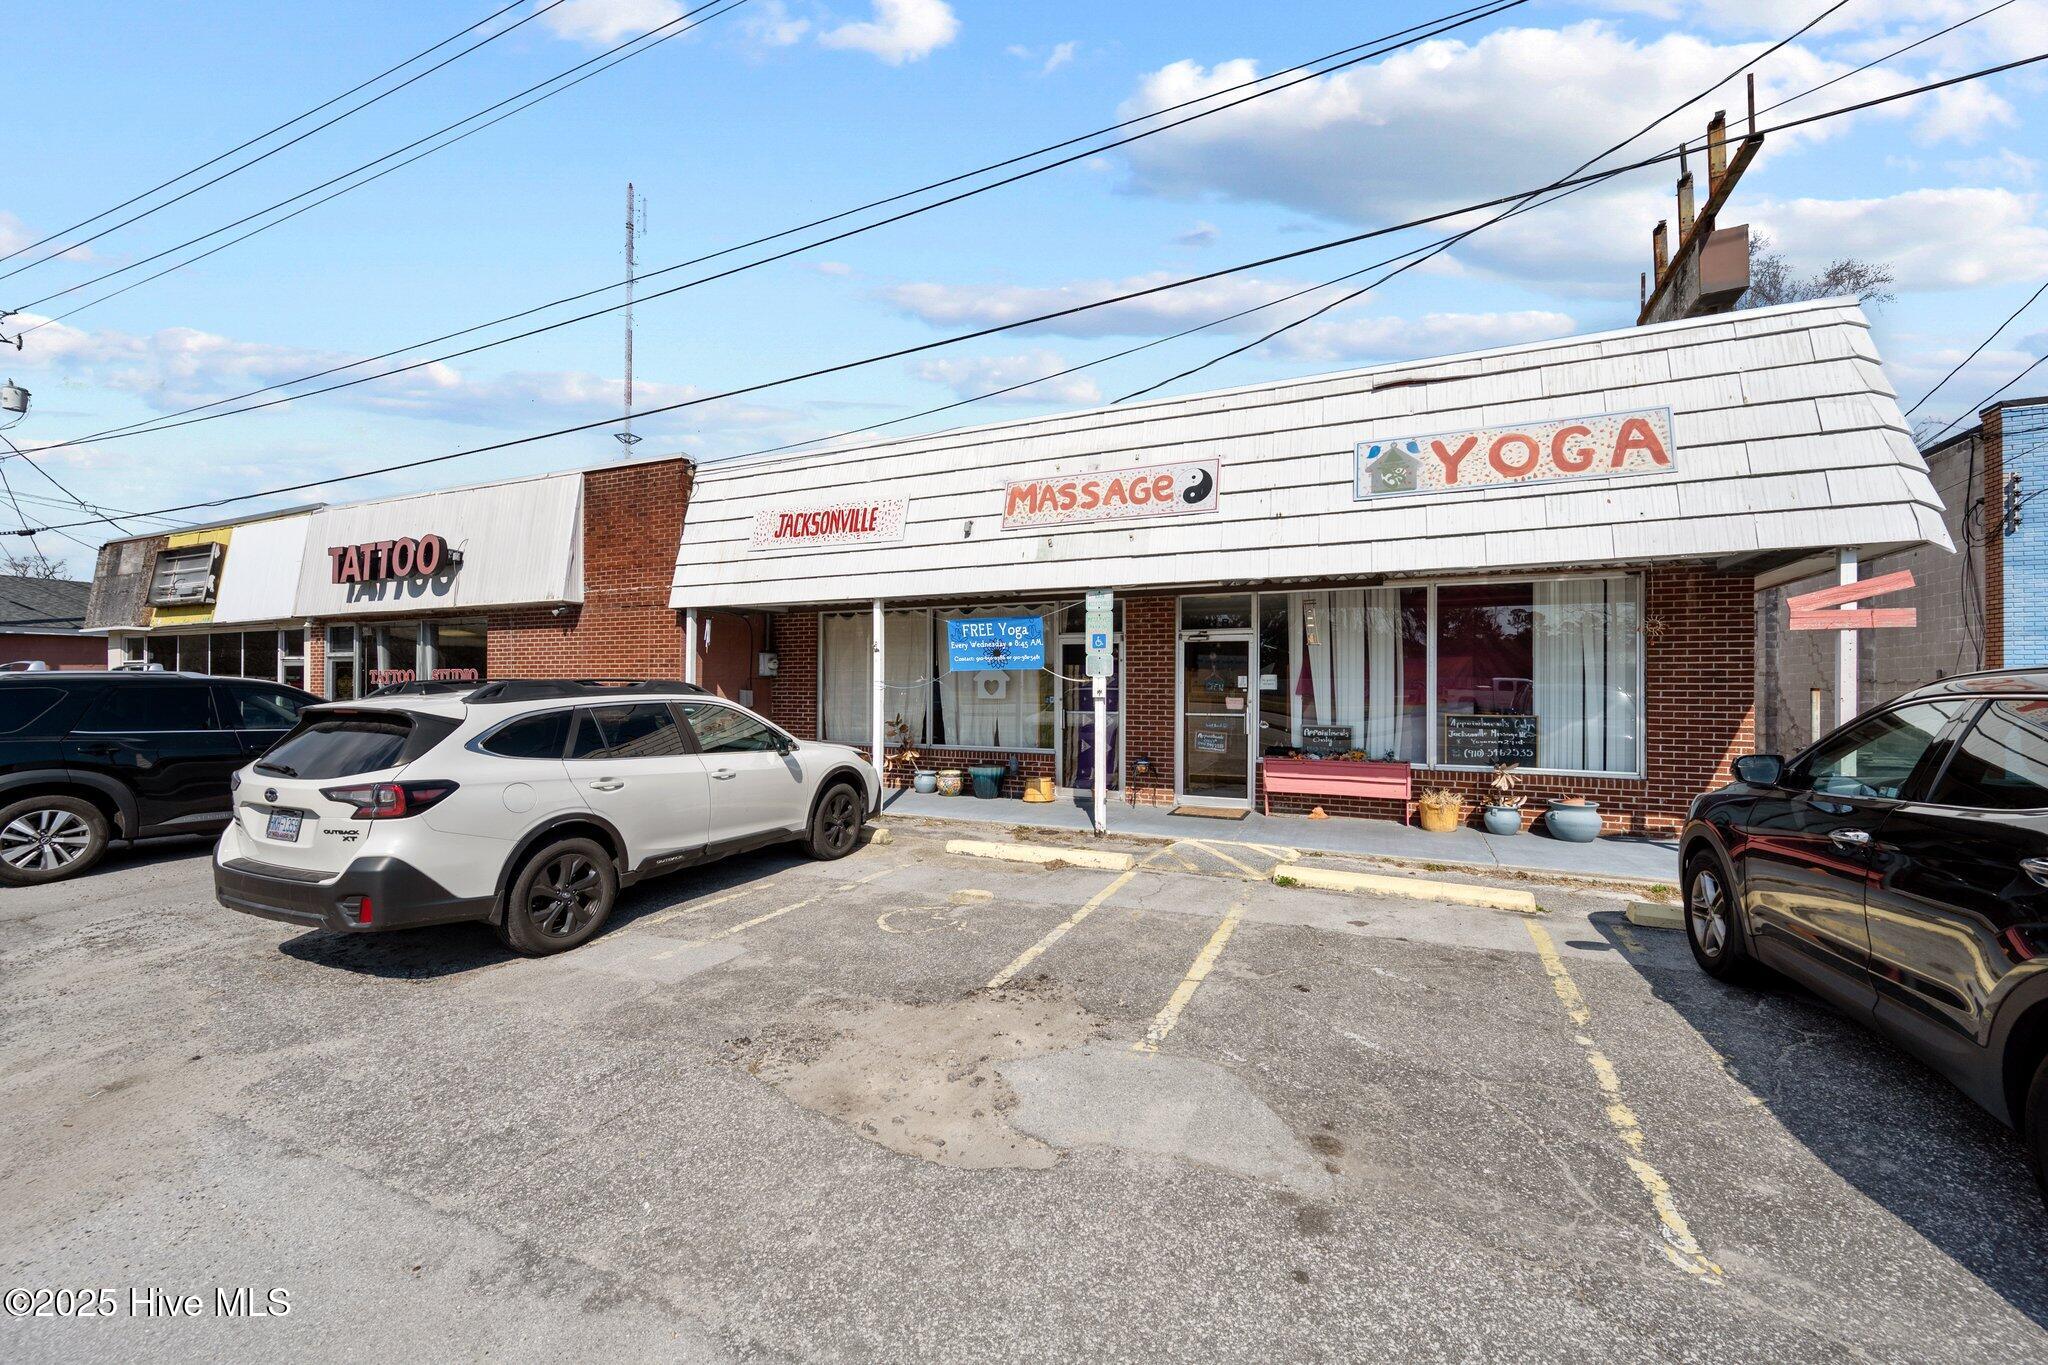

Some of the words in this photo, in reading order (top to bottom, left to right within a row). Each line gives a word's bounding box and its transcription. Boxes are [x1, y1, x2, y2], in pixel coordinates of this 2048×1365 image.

[1430, 418, 1671, 484] YOGA
[774, 506, 879, 539] JACKSONVILLE
[328, 534, 443, 584] TATTOO
[962, 623, 994, 637] FREE
[998, 622, 1029, 639] Yoga
[951, 641, 968, 651] Every
[969, 639, 1007, 650] Wednesday
[1014, 639, 1029, 649] 8:45
[369, 669, 416, 685] TATTOO
[432, 668, 479, 681] STUDIO
